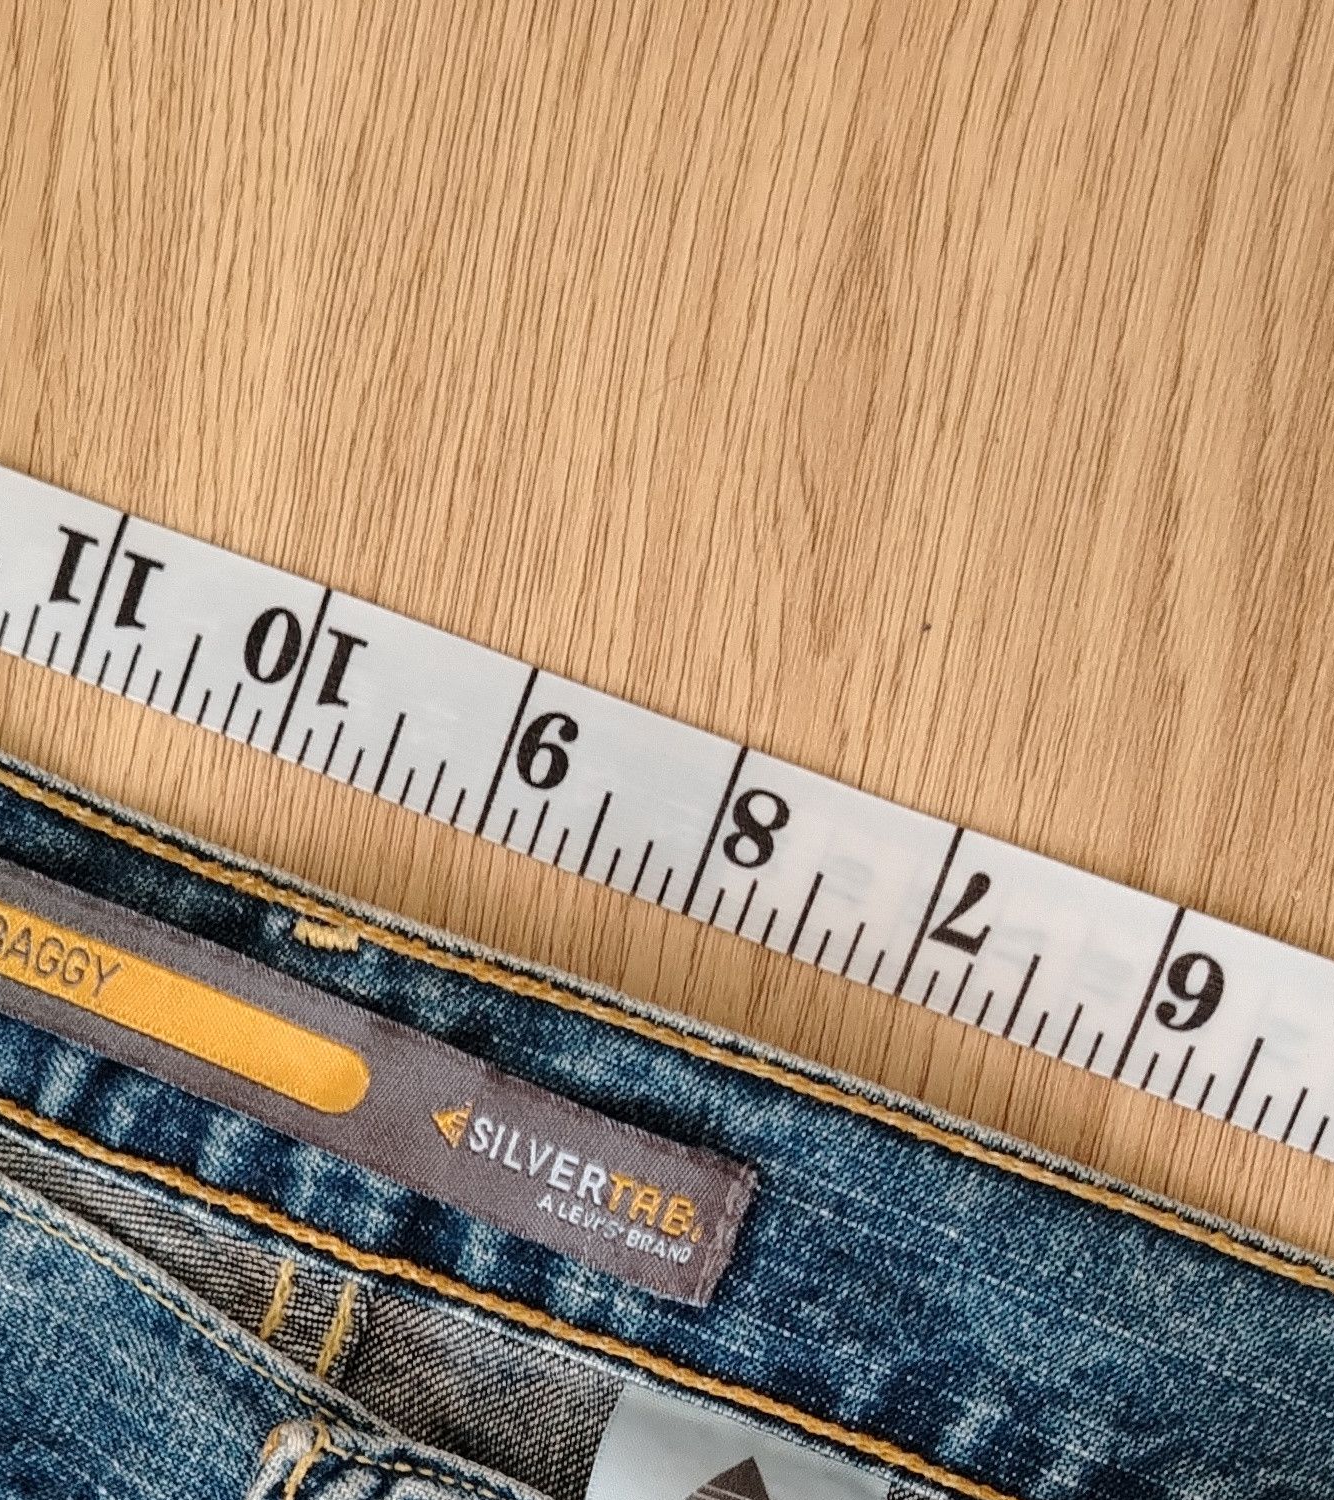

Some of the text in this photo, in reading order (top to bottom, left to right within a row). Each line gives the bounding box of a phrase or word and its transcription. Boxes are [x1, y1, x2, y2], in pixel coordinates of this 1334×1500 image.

[48, 525, 165, 629] 11
[243, 607, 368, 706] 10
[516, 711, 579, 789] 9
[722, 789, 790, 869] 8
[929, 871, 992, 955] 7
[1154, 952, 1225, 1032] 6
[537, 1194, 553, 1213] A
[626, 1229, 692, 1264] BRAND
